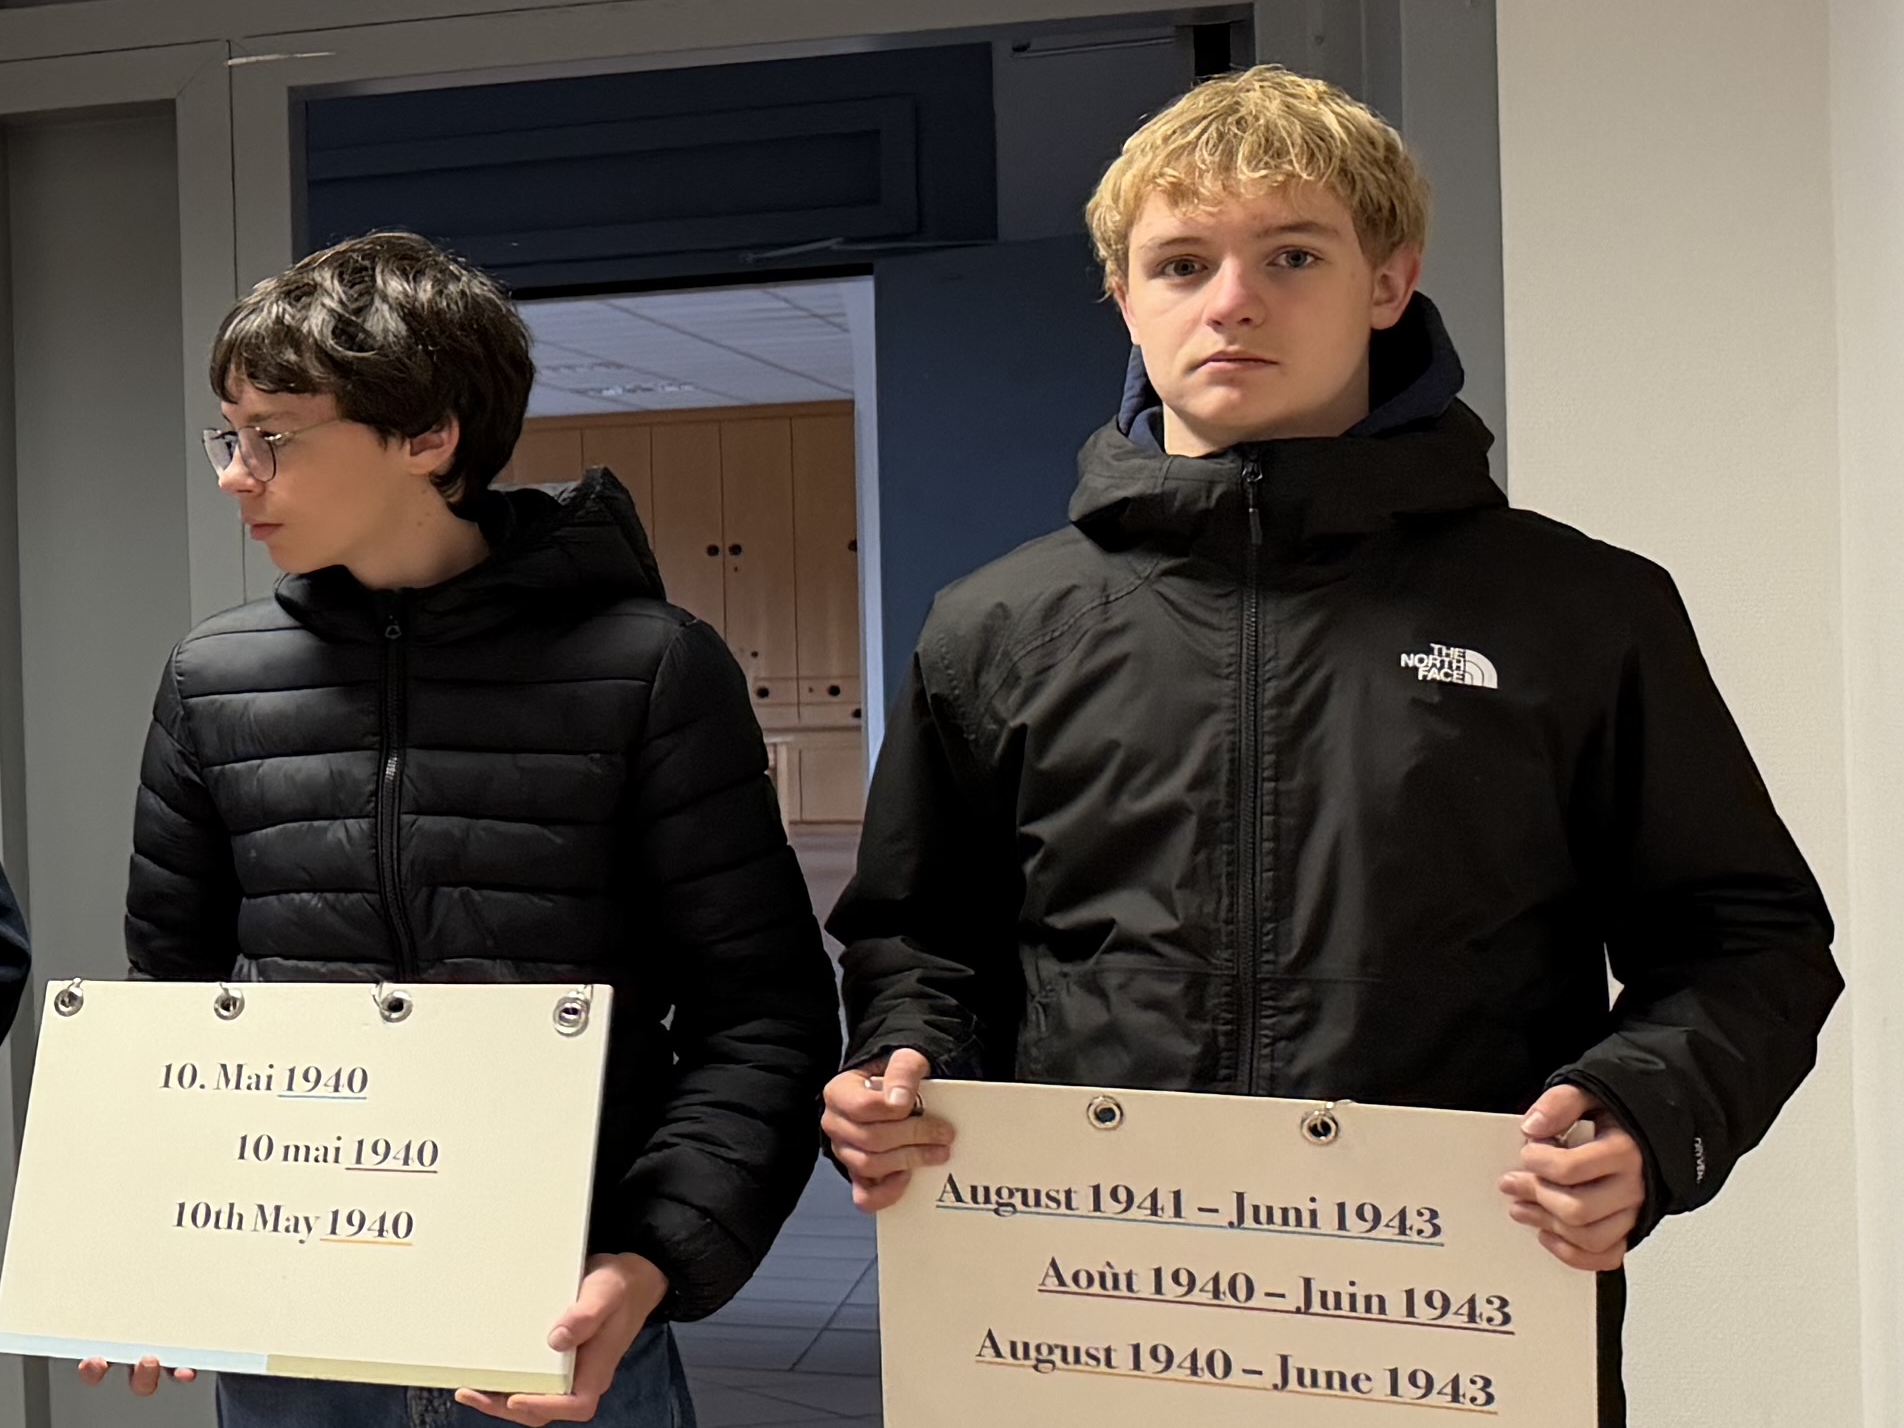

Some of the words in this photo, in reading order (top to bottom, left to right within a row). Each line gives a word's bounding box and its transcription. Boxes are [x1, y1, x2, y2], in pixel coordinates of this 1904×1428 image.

[1401, 654, 1463, 669] NORTH
[1431, 644, 1464, 658] THE
[1419, 668, 1463, 683] FACE
[159, 1063, 206, 1090] 10.
[214, 1064, 273, 1091] Mai
[283, 1066, 368, 1093] 1940
[236, 1134, 273, 1162] 10
[282, 1136, 341, 1164] mai
[353, 1138, 438, 1167] 1940
[173, 1202, 243, 1231] 10th
[253, 1204, 319, 1243] May
[327, 1209, 413, 1239] 1940
[936, 1173, 1076, 1216] August
[1088, 1184, 1184, 1218] 1941
[1228, 1192, 1320, 1230] Juni
[1334, 1201, 1442, 1240] 1943
[1151, 1266, 1254, 1304] 1940
[1296, 1277, 1388, 1316] Juin
[1403, 1287, 1512, 1327] 1943
[976, 1330, 1116, 1373] August
[1129, 1343, 1232, 1380] 1940
[1272, 1354, 1373, 1393] June
[1385, 1366, 1495, 1406] 1943
